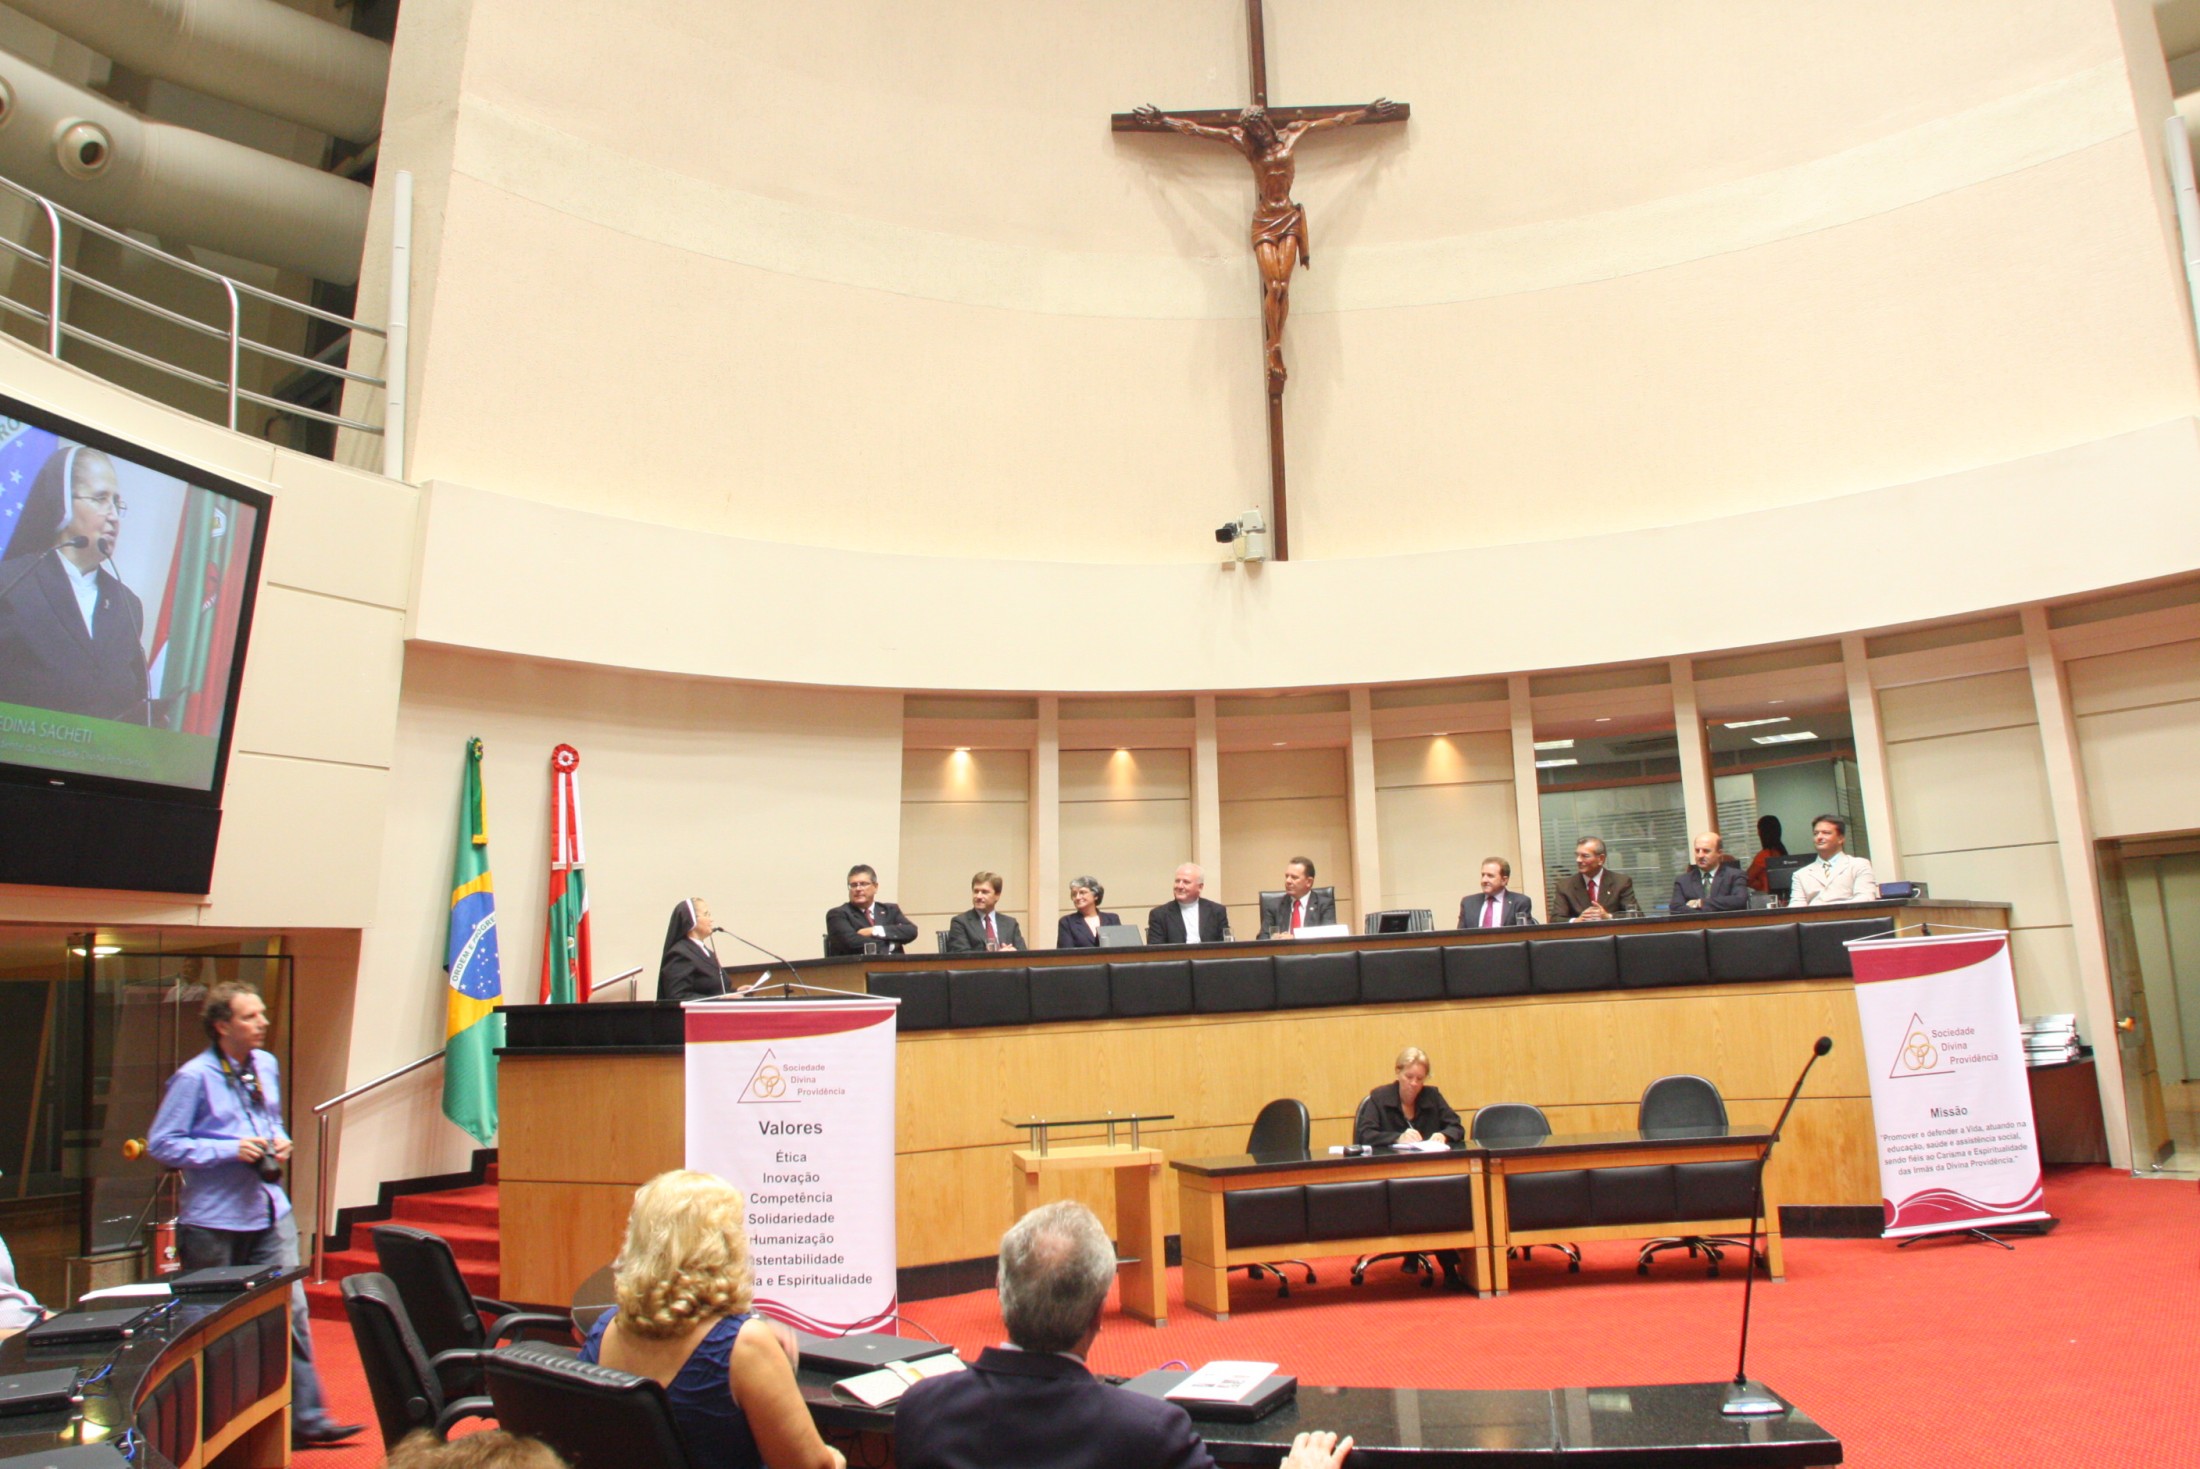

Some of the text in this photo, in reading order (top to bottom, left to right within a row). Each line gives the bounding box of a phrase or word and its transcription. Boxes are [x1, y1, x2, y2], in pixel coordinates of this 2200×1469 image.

[451, 950, 470, 982] ORDEM
[1931, 1026, 1975, 1038] Sociedade
[1941, 1042, 1968, 1052] Divina
[1949, 1053, 1999, 1065] Providência
[783, 1063, 826, 1072] Sociedade
[790, 1075, 817, 1084] Divina
[797, 1087, 846, 1096] Providência
[1930, 1105, 1968, 1119] Missão
[758, 1120, 823, 1136] Valores
[1926, 1128, 1959, 1138] defender
[1986, 1121, 2015, 1131] atuando
[775, 1149, 807, 1163] Ética
[1884, 1156, 1907, 1166] sendo
[1936, 1149, 1966, 1160] Carisma
[1973, 1143, 2028, 1156] Espiritualidade
[1898, 1167, 1912, 1176] das
[1946, 1160, 1969, 1171] Divina
[762, 1171, 820, 1185] Inovação
[750, 1191, 833, 1206] Competência
[748, 1211, 835, 1225] Solidariedade
[750, 1232, 834, 1246] Humanização
[766, 1276, 774, 1287] e
[777, 1273, 873, 1288] Espiritualidade
